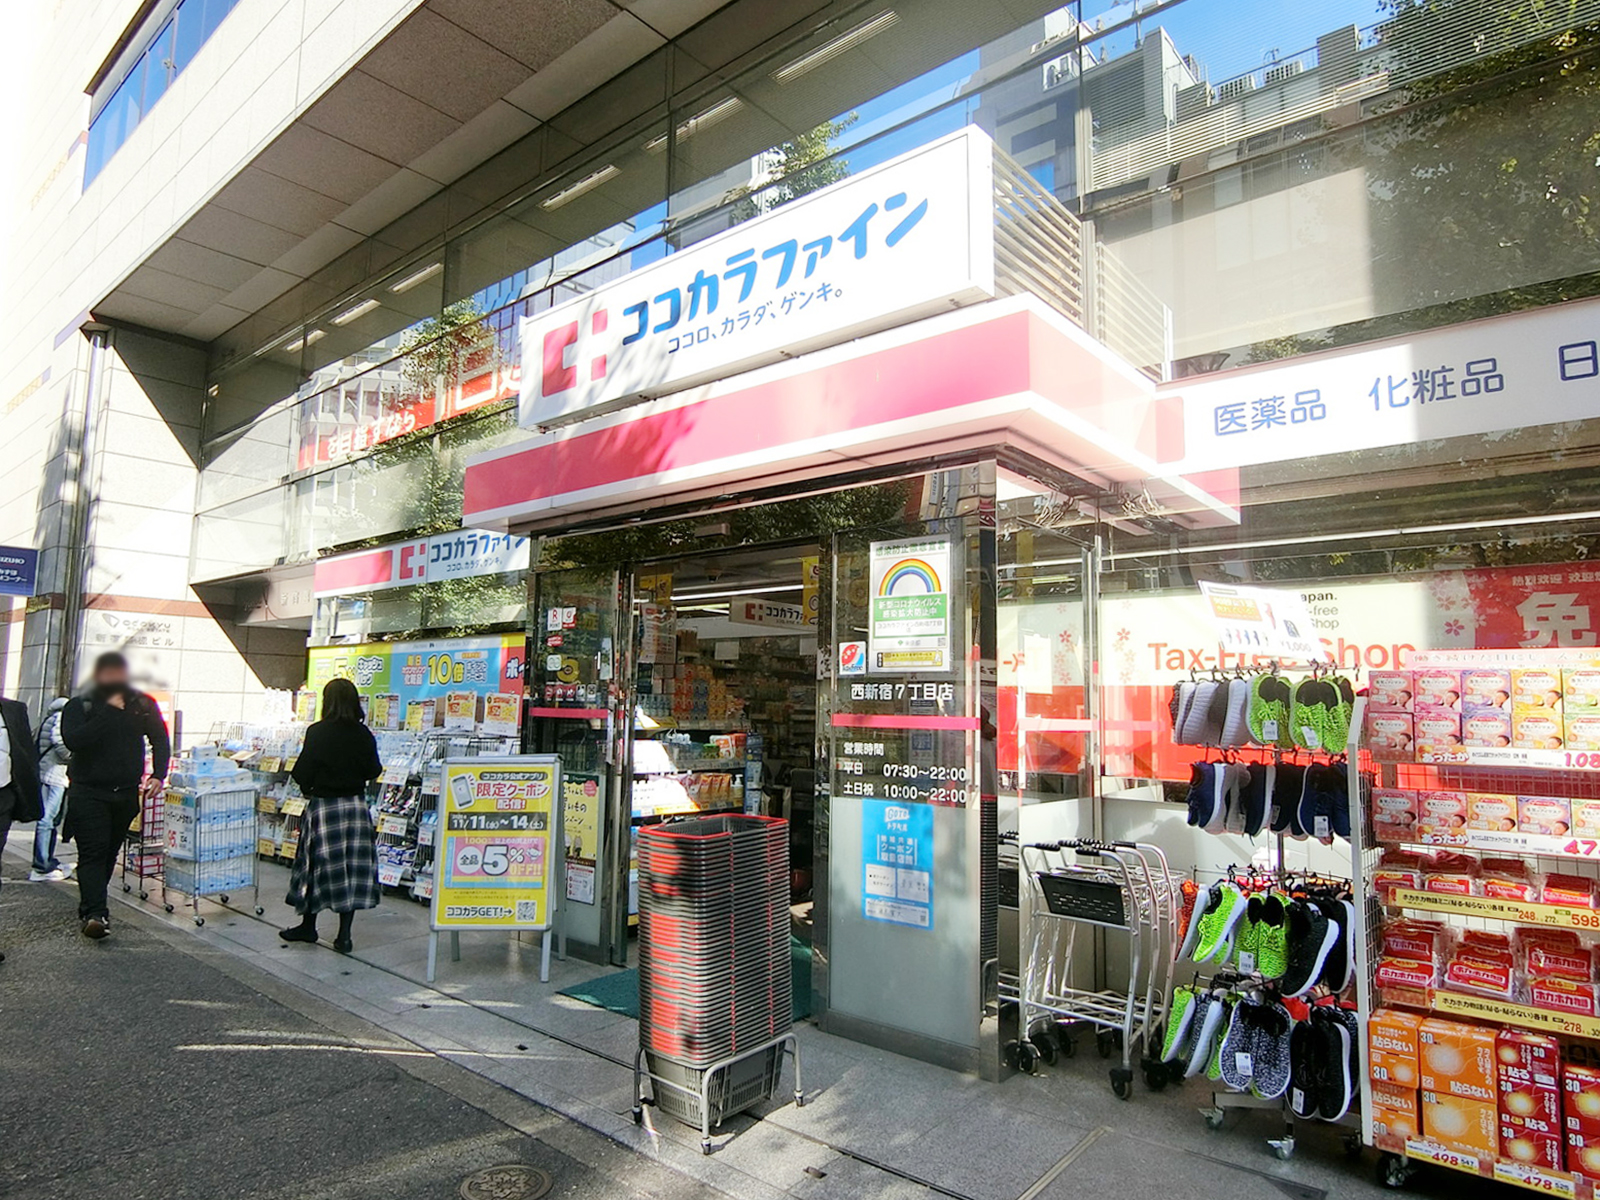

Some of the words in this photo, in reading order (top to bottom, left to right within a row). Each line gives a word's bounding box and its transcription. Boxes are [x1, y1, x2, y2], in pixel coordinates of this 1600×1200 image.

[622, 191, 928, 346] ココカラファイン
[668, 282, 843, 354] ココロ、カラダ、ゲンキ。
[1214, 389, 1327, 437] 医薬品
[1367, 357, 1505, 412] 化粧品
[1558, 340, 1599, 382] 日
[0, 556, 25, 565] IZUHO
[878, 597, 942, 610] 新型コロナウイルス
[1300, 592, 1338, 604] apan.
[882, 607, 938, 619] 感染拡大防止中
[1308, 605, 1339, 616] -free
[1515, 591, 1598, 648] 免
[1317, 637, 1416, 671] Shop
[428, 654, 464, 685] 10倍
[850, 683, 953, 701] 西新宿7丁目店
[843, 742, 884, 756] 営業時間
[843, 762, 864, 776] 平日
[483, 773, 544, 781] ココカラ公式アプリ
[476, 783, 549, 798] 限定クーポン
[843, 782, 874, 797] 土日祝
[497, 799, 526, 810] 配信!
[880, 842, 914, 854] クーポン
[1563, 839, 1600, 856] 47
[460, 854, 479, 866] 全品
[481, 844, 525, 876] 5%
[1571, 914, 1600, 928] 598
[1563, 1021, 1582, 1034] 278
[1372, 1034, 1414, 1052] 貼らない
[1420, 1031, 1434, 1044] 30
[1532, 1046, 1545, 1058] 30
[1373, 1065, 1388, 1080] 30
[1507, 1066, 1530, 1080] 貼る
[1450, 1080, 1494, 1099] 貼らない
[1500, 1081, 1513, 1092] 30
[1565, 1079, 1580, 1093] 30
[1423, 1091, 1437, 1104] 30
[1524, 1117, 1549, 1132] 貼る
[1502, 1127, 1514, 1139] 30
[1568, 1133, 1584, 1147] 30
[1431, 1152, 1459, 1166] 498
[1523, 1176, 1552, 1190] 478
